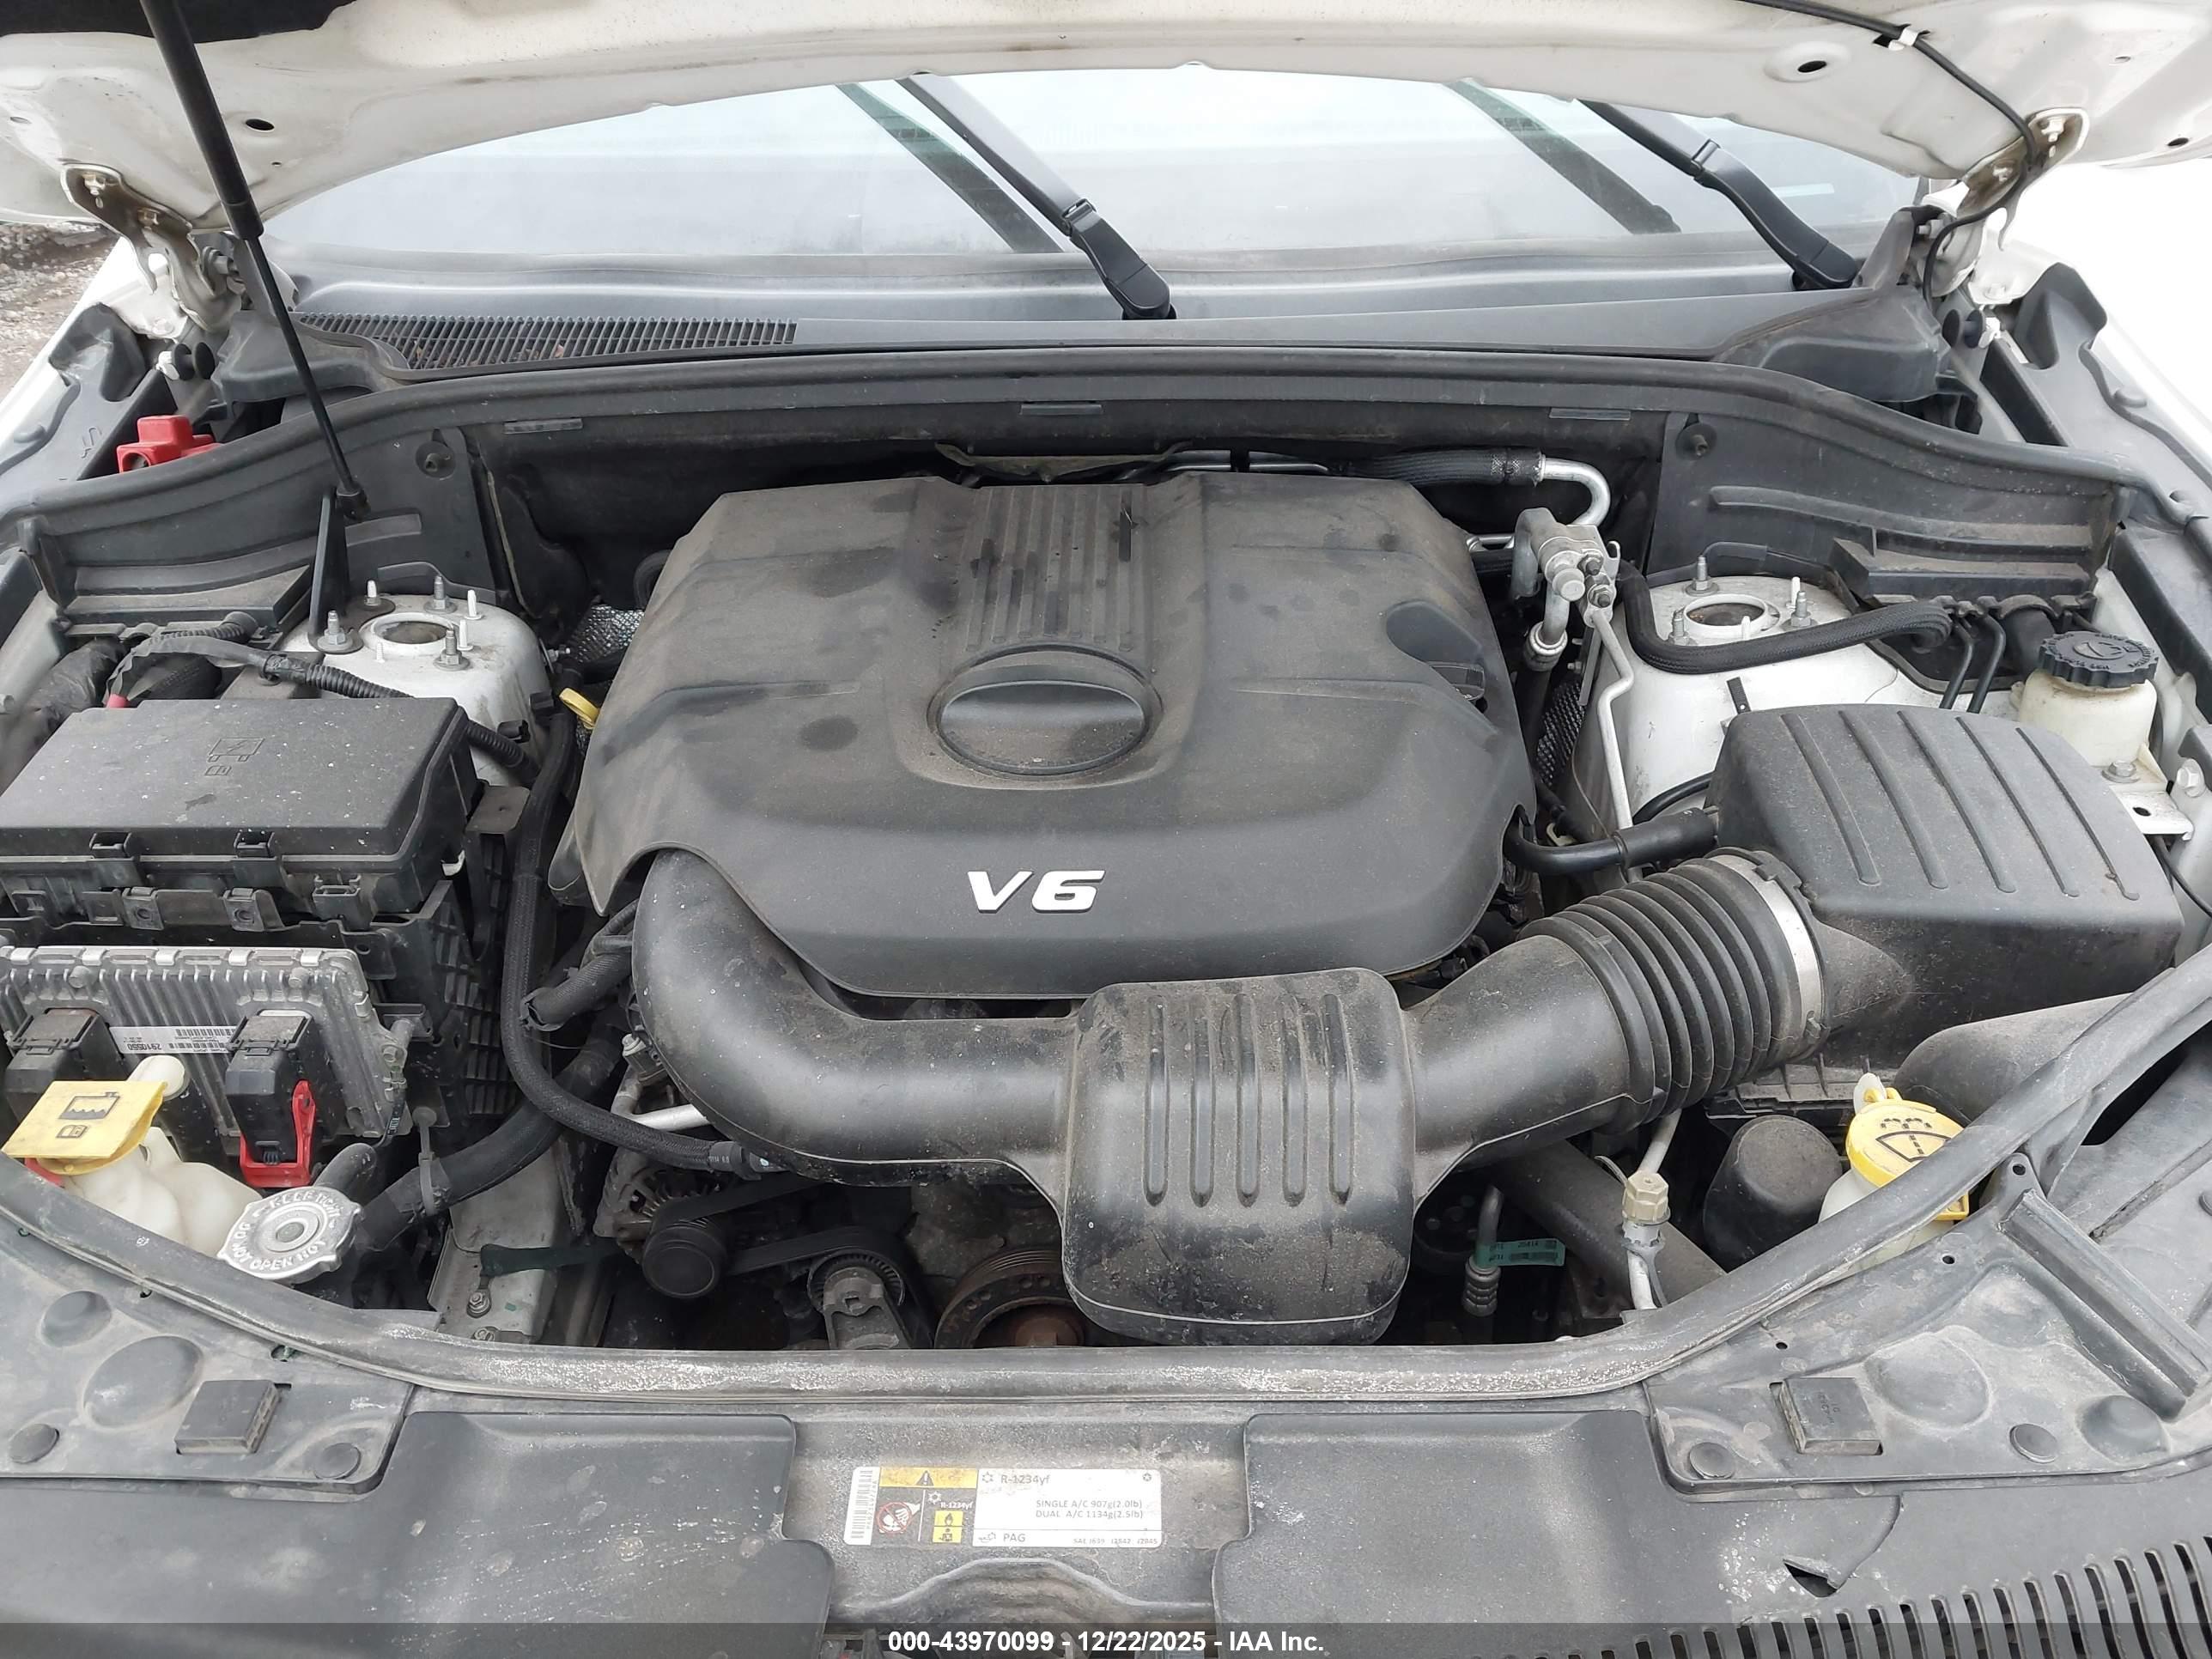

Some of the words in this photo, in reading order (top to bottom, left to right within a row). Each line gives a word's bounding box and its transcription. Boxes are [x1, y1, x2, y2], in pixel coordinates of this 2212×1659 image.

[967, 870, 1106, 914] V6
[232, 1243, 253, 1263] NOT
[250, 1256, 294, 1271] OPEN
[295, 1239, 326, 1261] HOT
[1001, 1474, 1050, 1486] R-1234yf
[1036, 1499, 1067, 1508] SINGLE
[1071, 1500, 1088, 1509] A/C
[1036, 1510, 1060, 1518] DUAL
[1066, 1510, 1084, 1518] A/C
[1003, 1533, 1026, 1542] PAG
